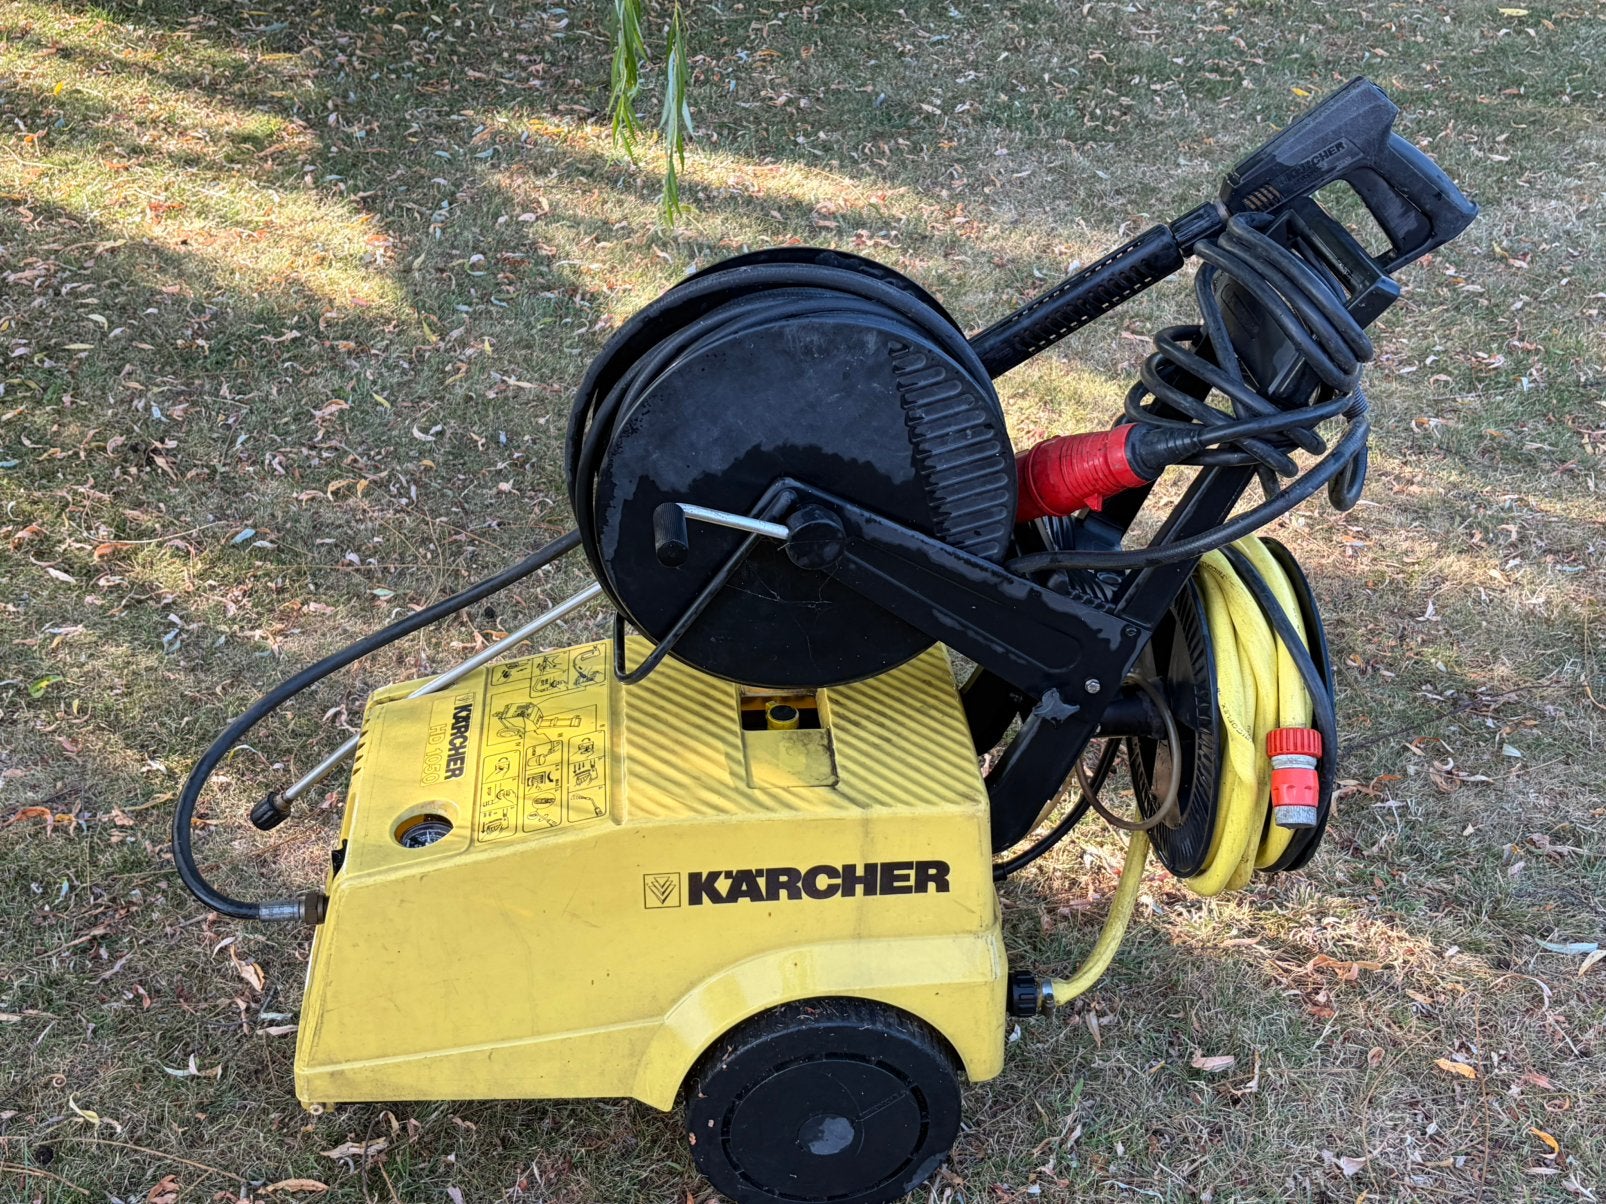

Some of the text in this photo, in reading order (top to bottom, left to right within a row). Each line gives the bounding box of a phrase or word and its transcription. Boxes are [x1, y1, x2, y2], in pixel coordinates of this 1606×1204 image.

[422, 723, 447, 785] HD 1050
[444, 703, 472, 780] KÄRCHER
[688, 860, 950, 906] KÄRCHER
